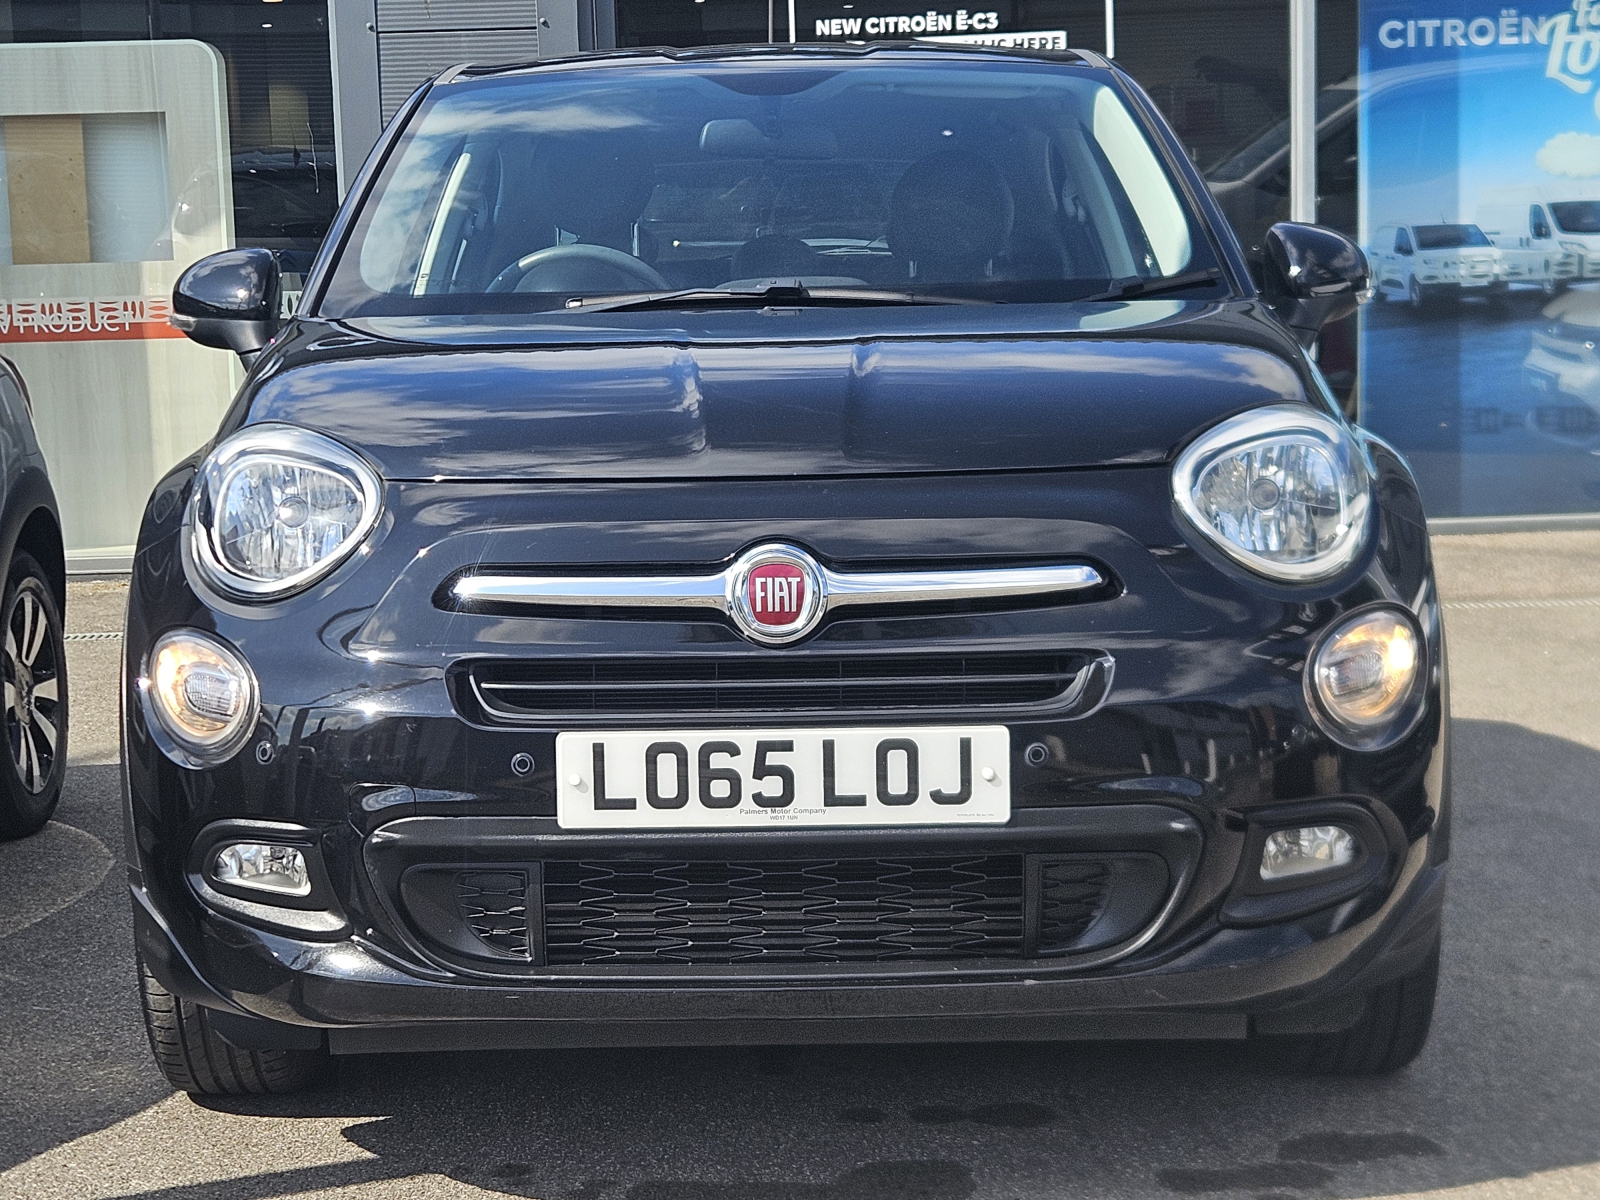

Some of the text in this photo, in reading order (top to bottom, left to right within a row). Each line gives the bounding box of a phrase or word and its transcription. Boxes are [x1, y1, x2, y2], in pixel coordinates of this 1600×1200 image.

[815, 10, 999, 36] NEW CITROËN Ë-C3
[1378, 9, 1547, 48] CITROËN
[1013, 36, 1061, 49] HERE
[755, 577, 801, 613] FIAT
[592, 737, 973, 810] LO65 LOJ
[793, 807, 827, 815] Company
